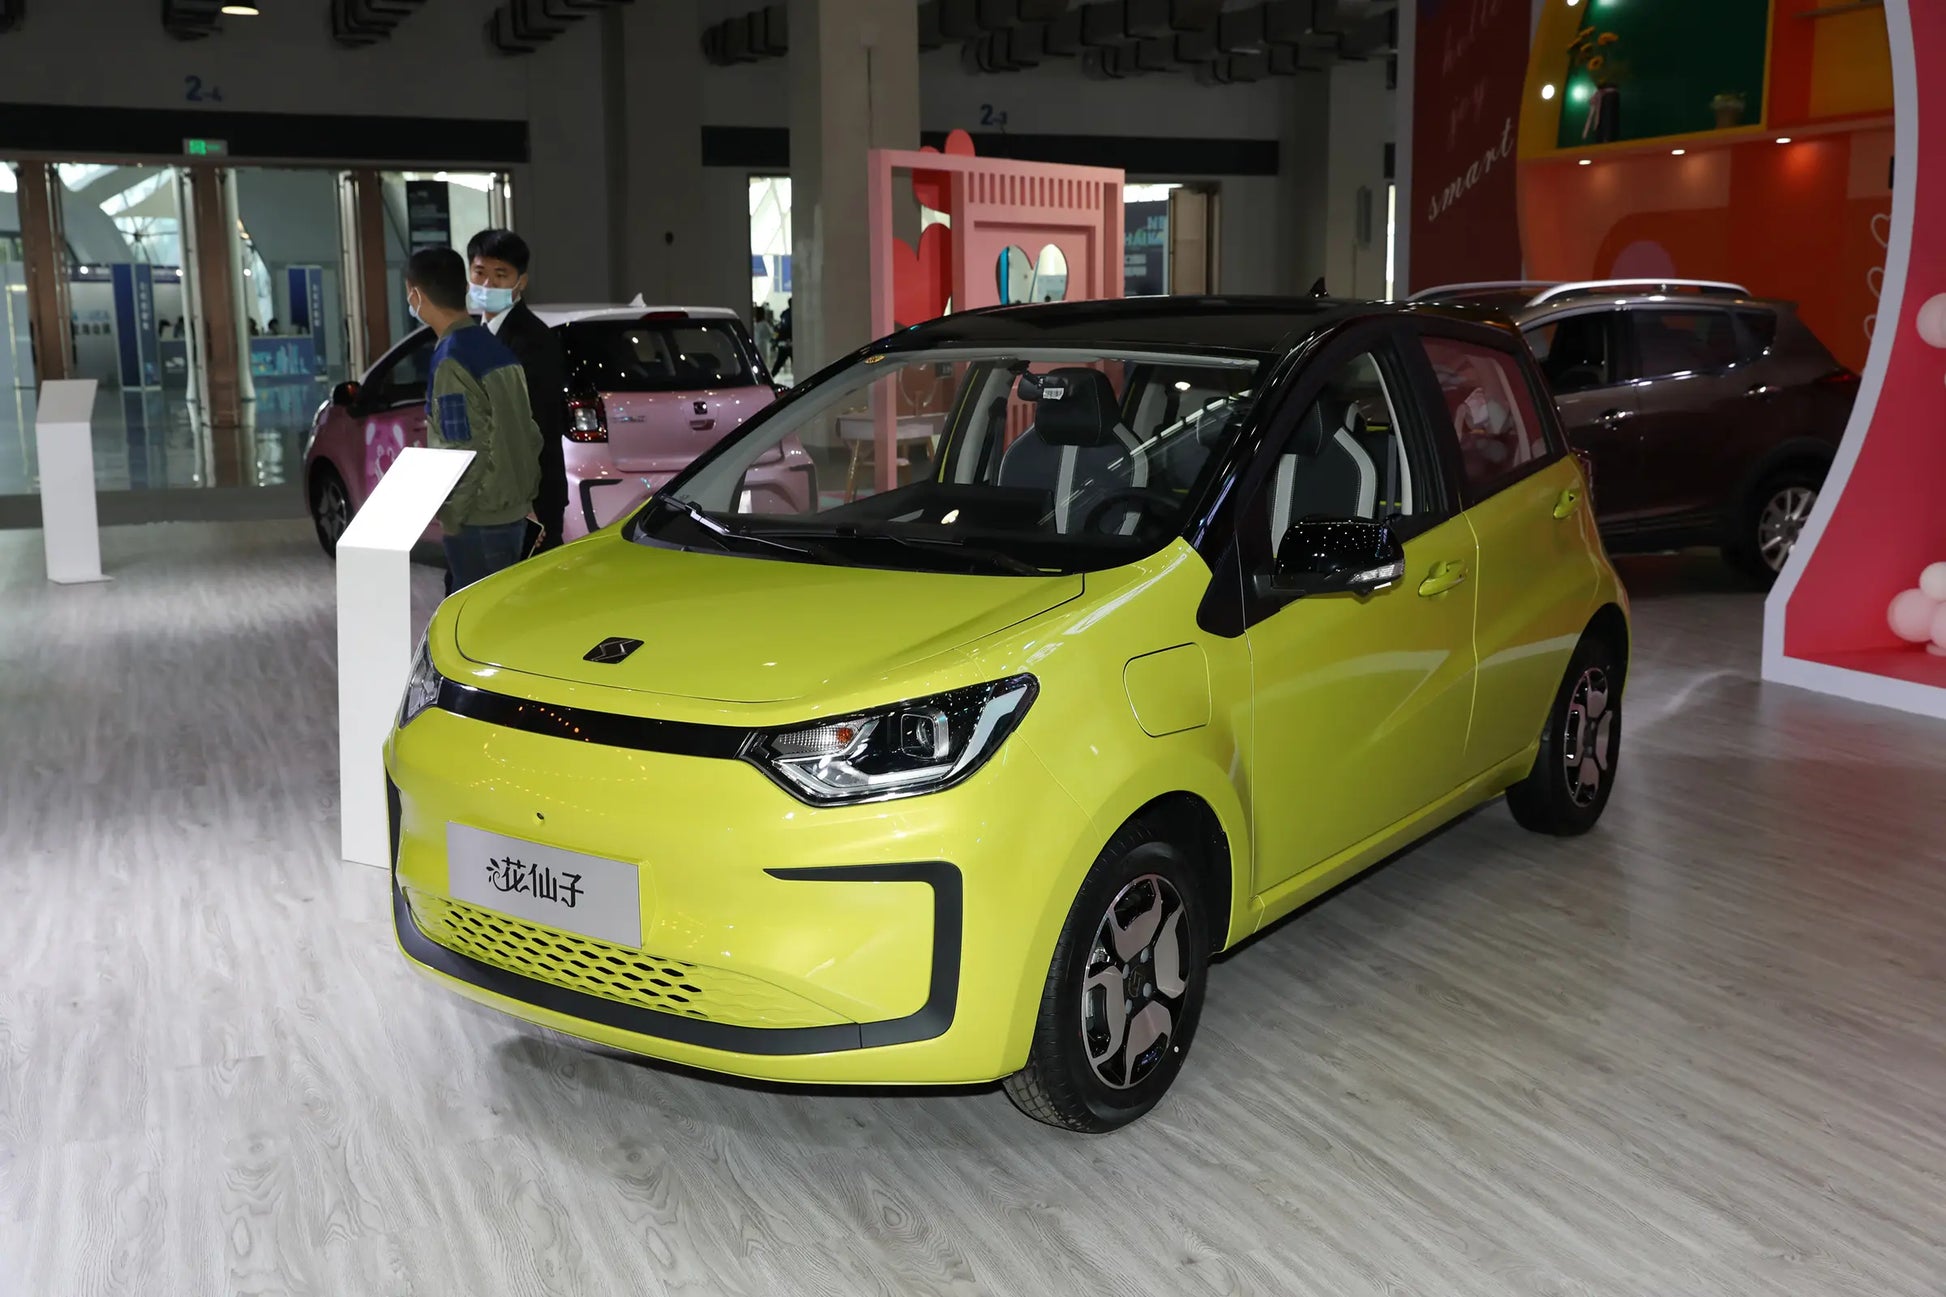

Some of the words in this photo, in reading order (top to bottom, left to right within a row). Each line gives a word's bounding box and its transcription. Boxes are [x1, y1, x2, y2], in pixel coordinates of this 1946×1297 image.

[1427, 117, 1514, 222] smart
[486, 856, 584, 908] 花仙子
